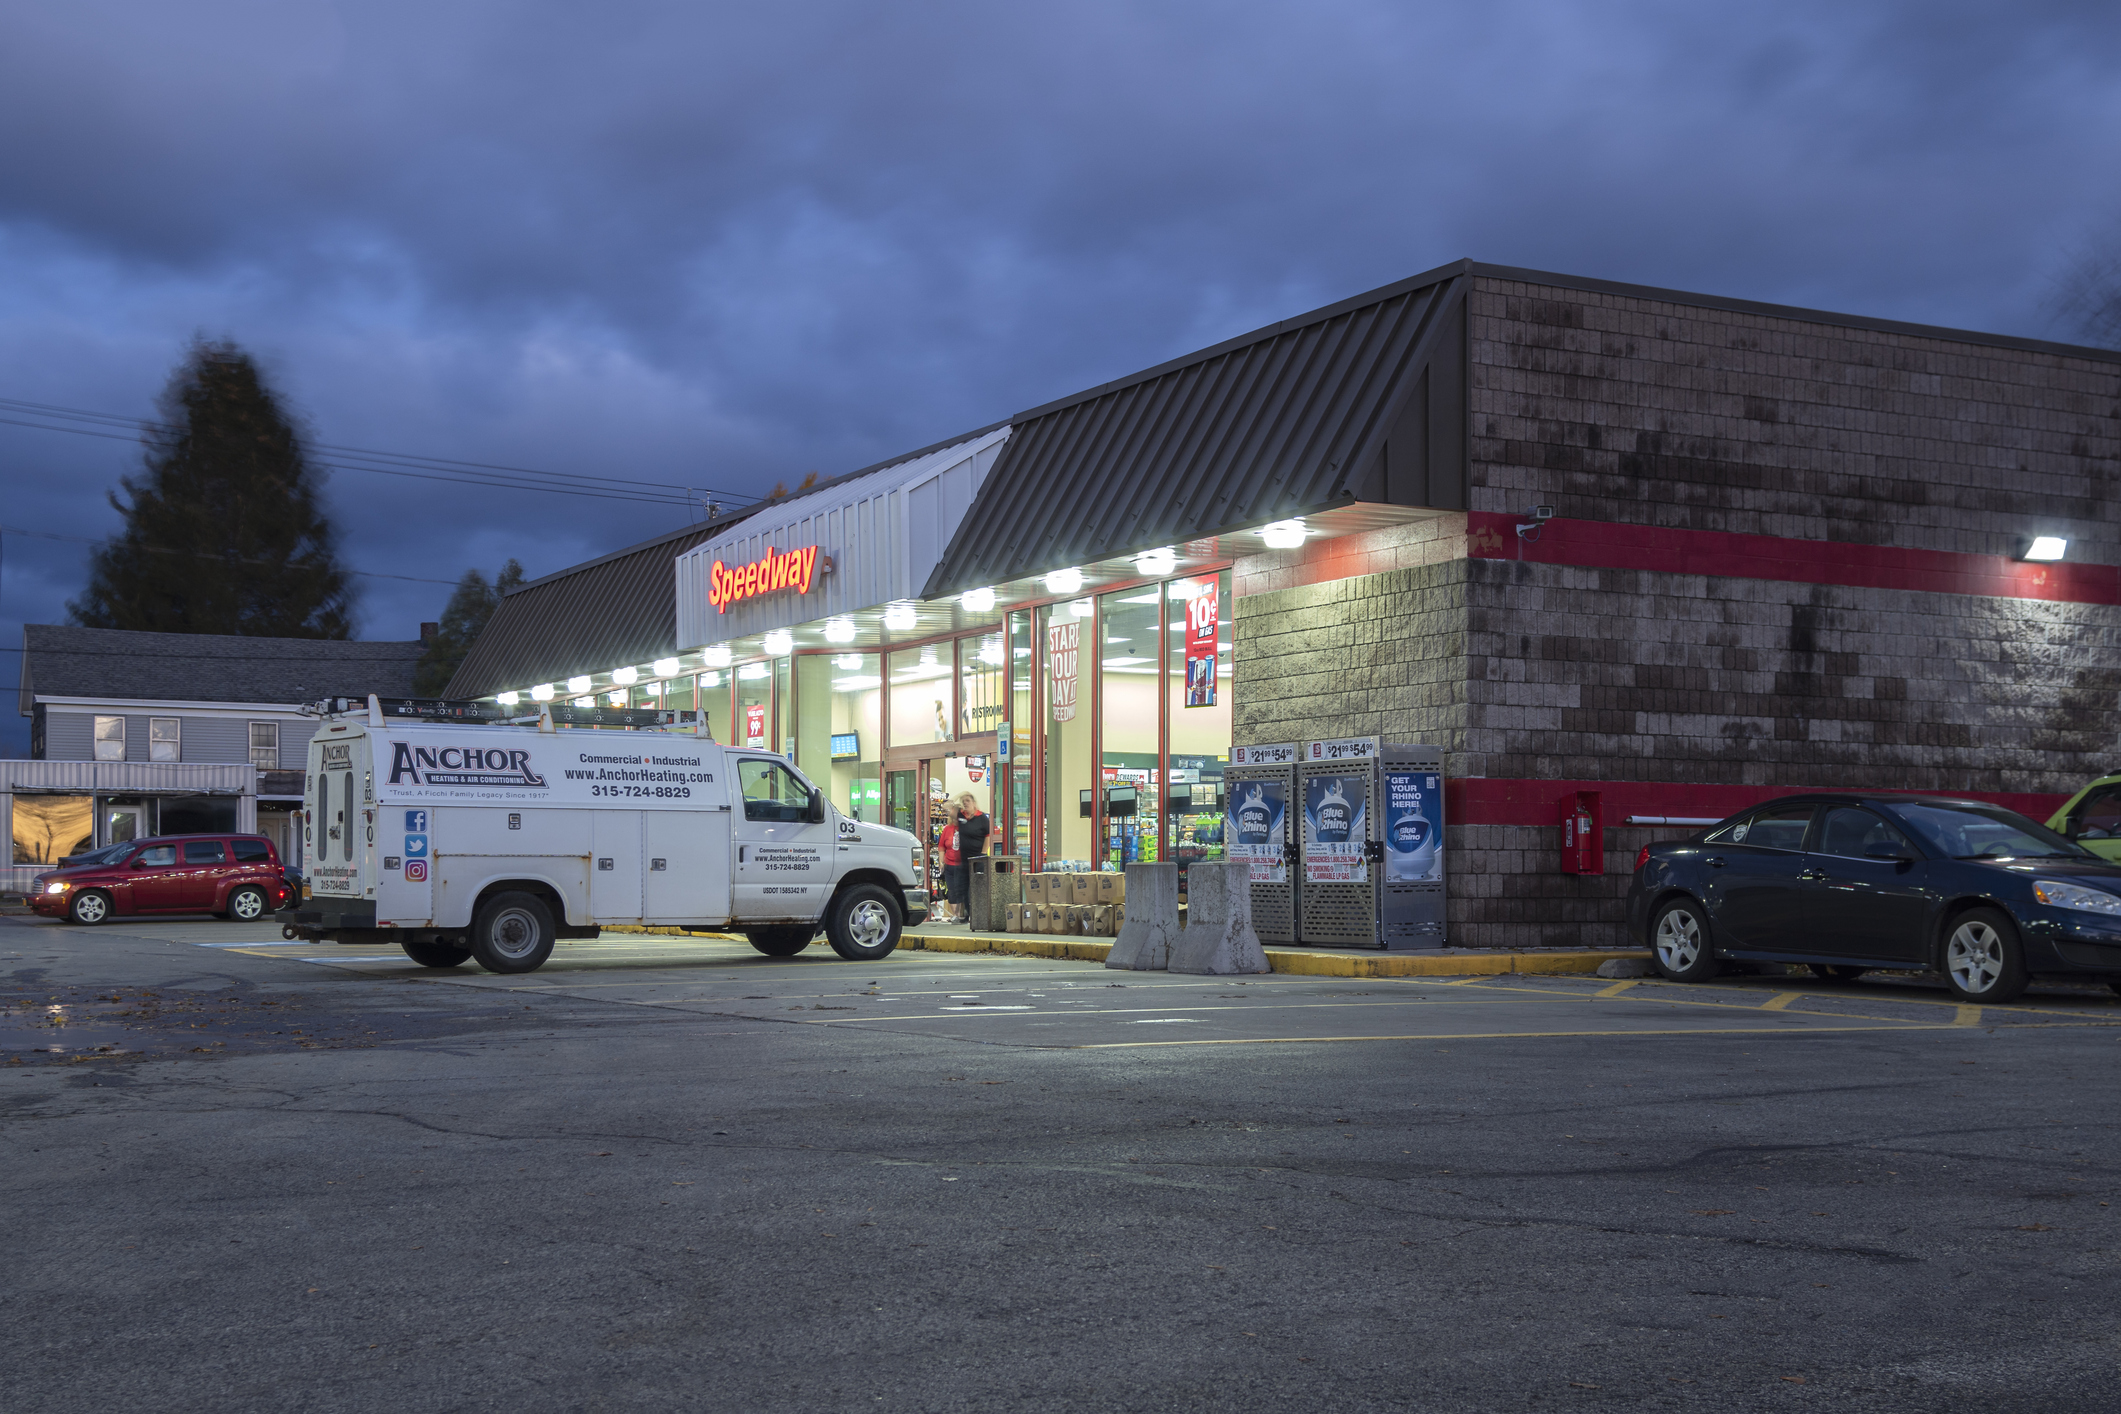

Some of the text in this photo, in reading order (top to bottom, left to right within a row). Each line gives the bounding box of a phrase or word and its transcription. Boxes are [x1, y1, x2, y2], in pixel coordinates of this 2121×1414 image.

[709, 545, 818, 614] Speedway
[1189, 598, 1216, 630] 10¢
[1050, 623, 1079, 651] START
[1051, 650, 1077, 678] YOUR
[1052, 679, 1077, 705] DAY AT
[321, 744, 351, 771] ANCHOR
[387, 741, 542, 785] ANCHOR
[579, 753, 701, 767] Commercial Industrial
[431, 775, 459, 783] HEATING
[460, 775, 466, 783] &
[480, 776, 525, 784] CONDITIONING
[564, 768, 713, 785] www.AnchorHeating.com
[365, 789, 372, 800] 03
[450, 790, 474, 798] Family
[477, 791, 504, 799] Legacy
[591, 785, 690, 798] 315-724-8829
[1244, 811, 1263, 821] Blue
[1323, 807, 1343, 818] Blue
[839, 822, 855, 833] 03
[755, 855, 820, 863] www.AnchorHeating.com
[1313, 872, 1335, 880] FLAMMABLE
[1341, 872, 1349, 880] GAS
[321, 880, 350, 890] 315-724-8829
